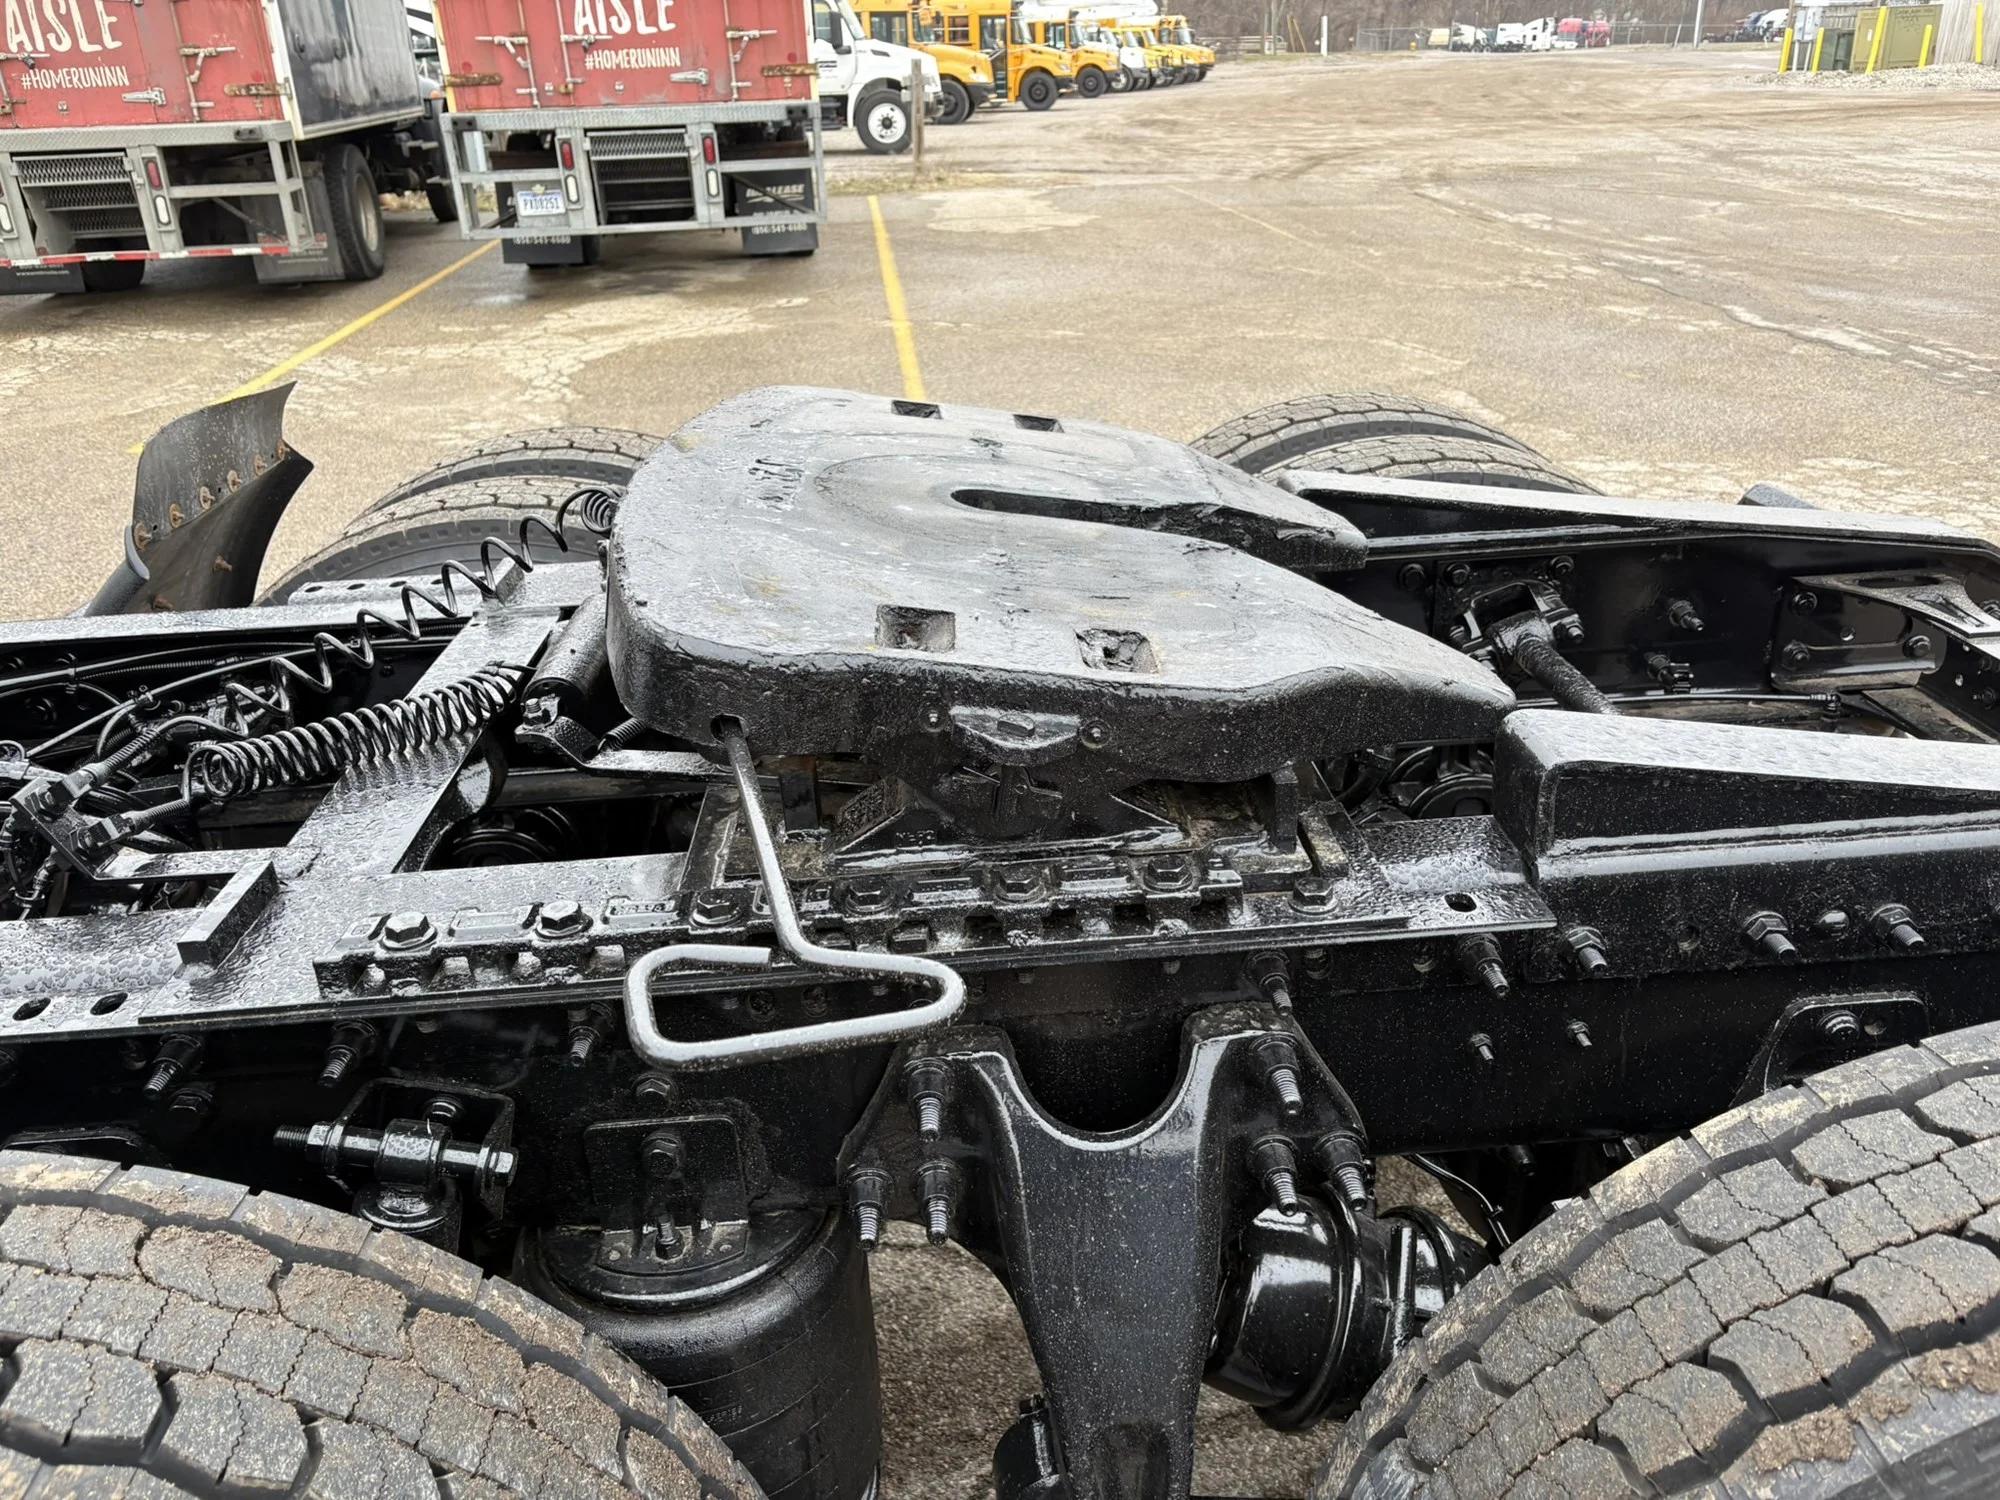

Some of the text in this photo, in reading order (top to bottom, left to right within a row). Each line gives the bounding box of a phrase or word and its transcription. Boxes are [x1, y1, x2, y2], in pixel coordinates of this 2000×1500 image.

[5, 0, 123, 53] AISLE
[573, 0, 677, 35] AISLE
[584, 47, 681, 70] #HOMERUNINN
[20, 65, 130, 90] #HOMERUNINN
